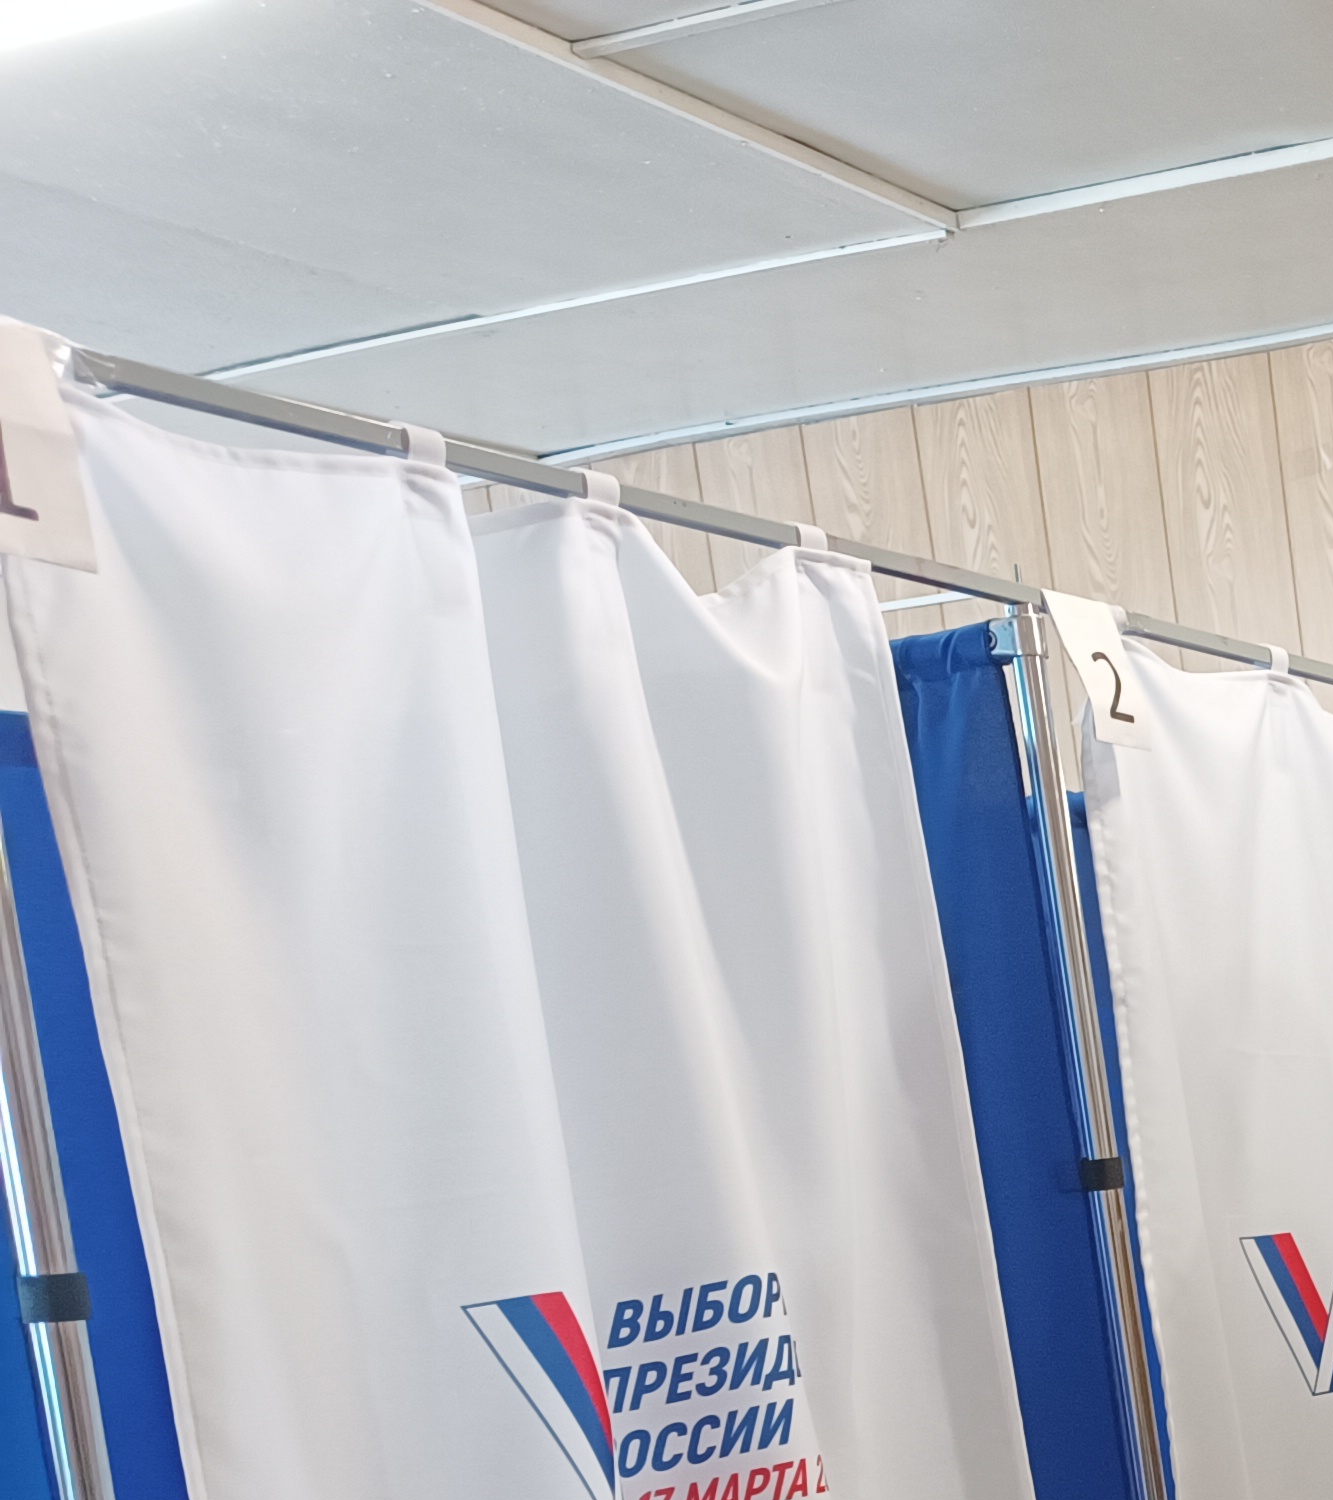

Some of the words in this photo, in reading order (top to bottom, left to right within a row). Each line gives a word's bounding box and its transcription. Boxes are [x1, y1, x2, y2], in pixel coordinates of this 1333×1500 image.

[1091, 651, 1135, 724] 2
[607, 1272, 787, 1349] ВЫБОР
[602, 1335, 802, 1414] ПРЕЗИД
[614, 1398, 794, 1478] ОССИИ
